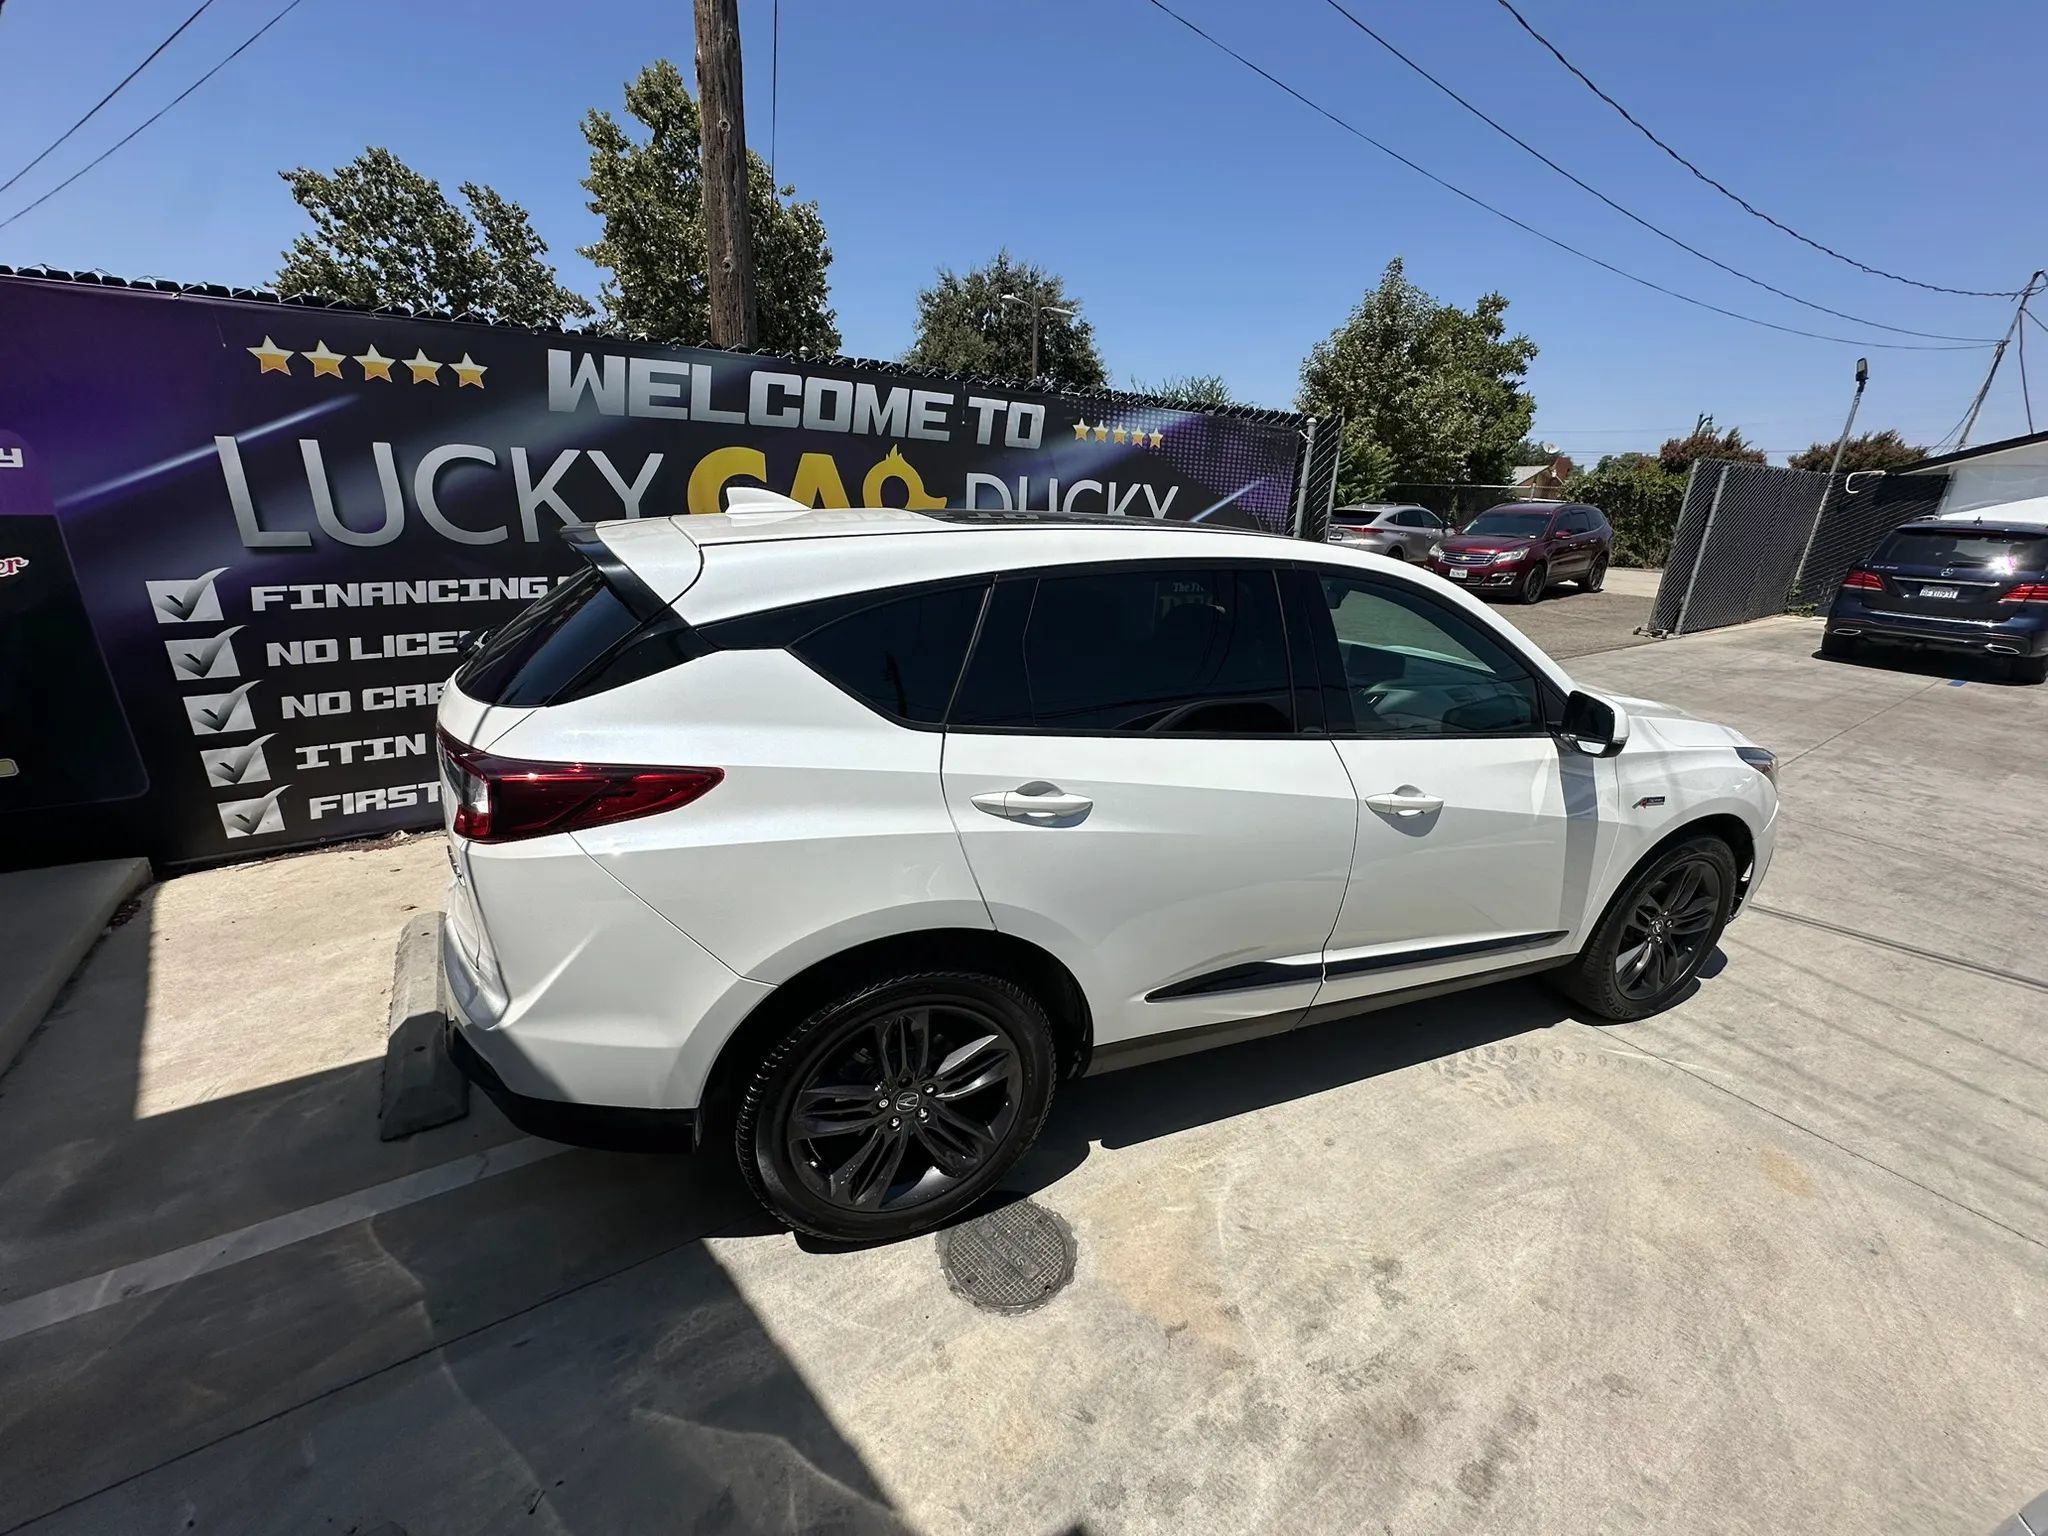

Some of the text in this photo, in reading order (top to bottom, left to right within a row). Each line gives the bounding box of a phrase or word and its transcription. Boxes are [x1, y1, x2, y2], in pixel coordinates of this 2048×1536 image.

[547, 349, 1046, 449] WELCOME TO
[214, 435, 664, 547] LUCKY
[251, 575, 549, 612] FINANCING
[266, 637, 339, 667] NO
[282, 690, 352, 720] NO
[295, 733, 427, 770] ITIN
[309, 781, 443, 820] FIRST
